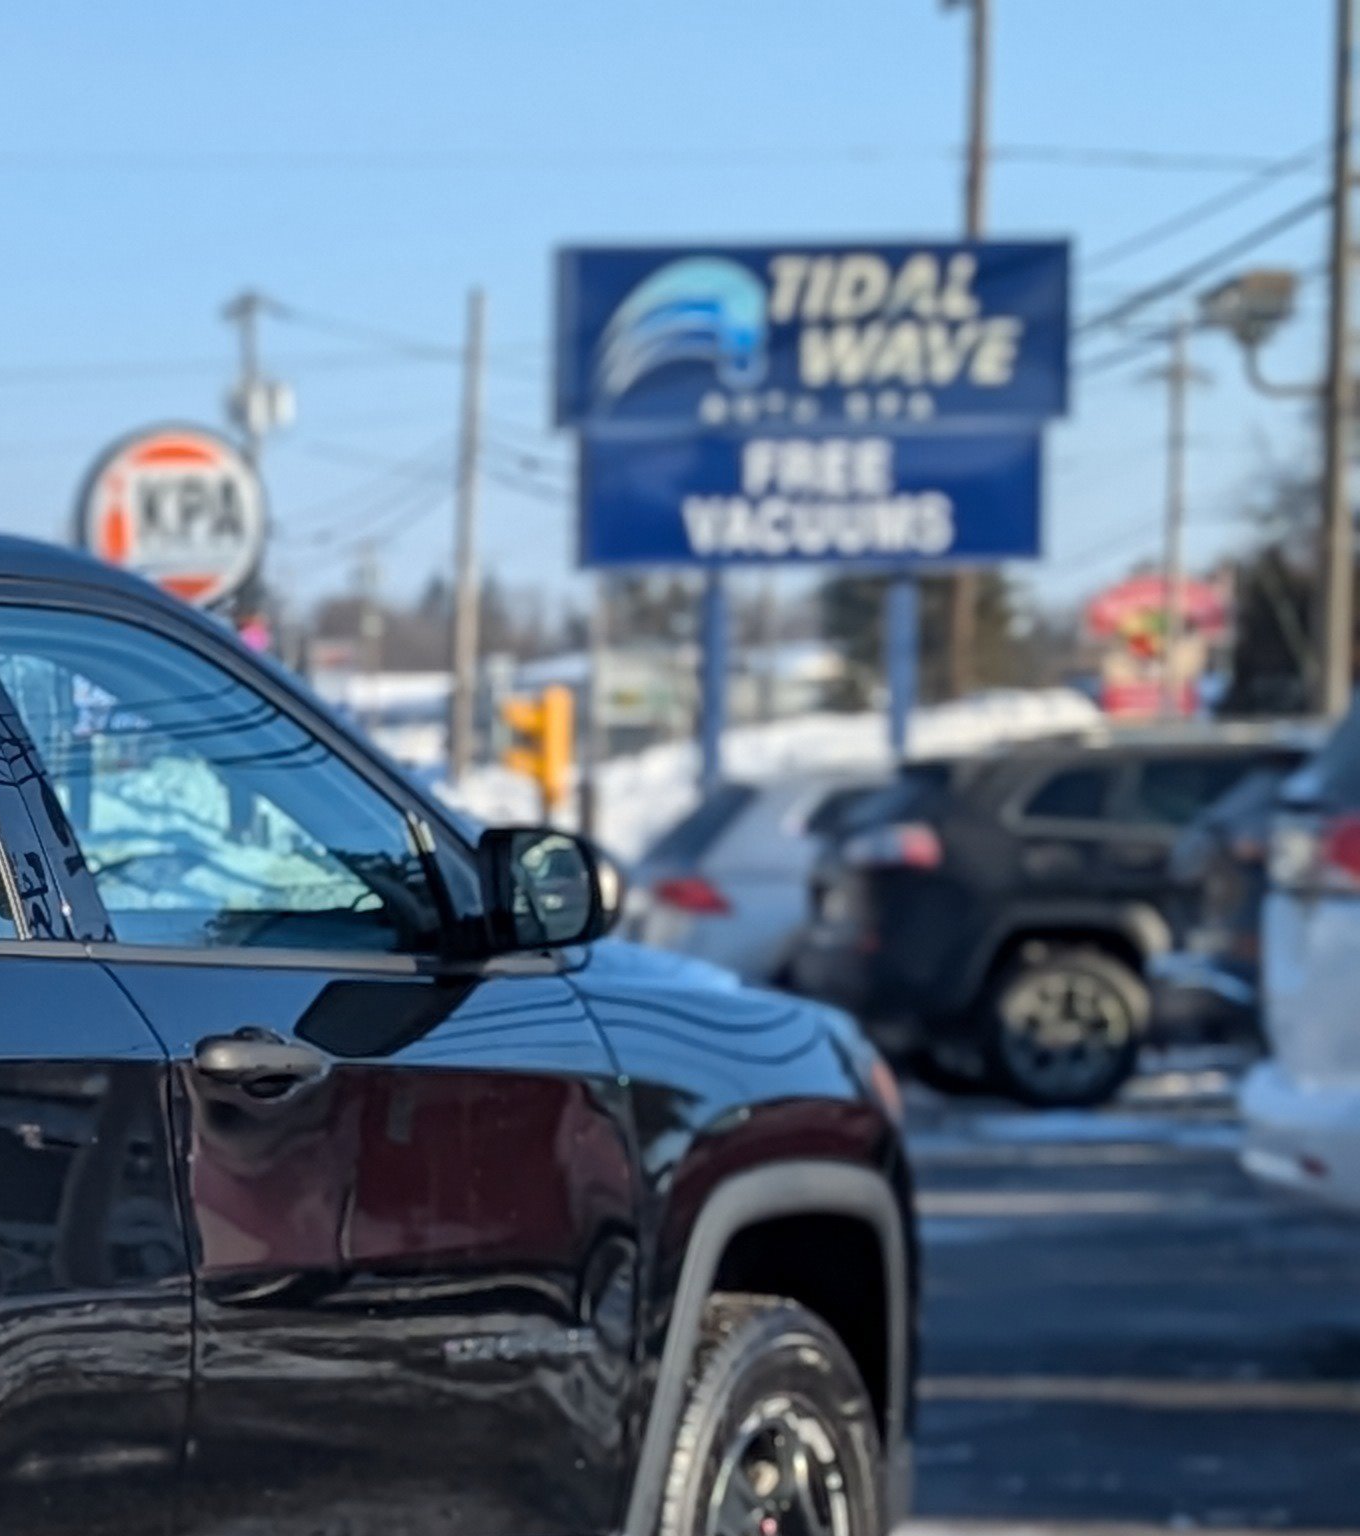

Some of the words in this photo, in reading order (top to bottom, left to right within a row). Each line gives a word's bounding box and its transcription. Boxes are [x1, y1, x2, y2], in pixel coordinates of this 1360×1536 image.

[768, 252, 979, 324] TIDAL
[798, 315, 1025, 388] WAVE
[742, 438, 894, 498] FREE
[682, 490, 955, 557] VACUUMS
